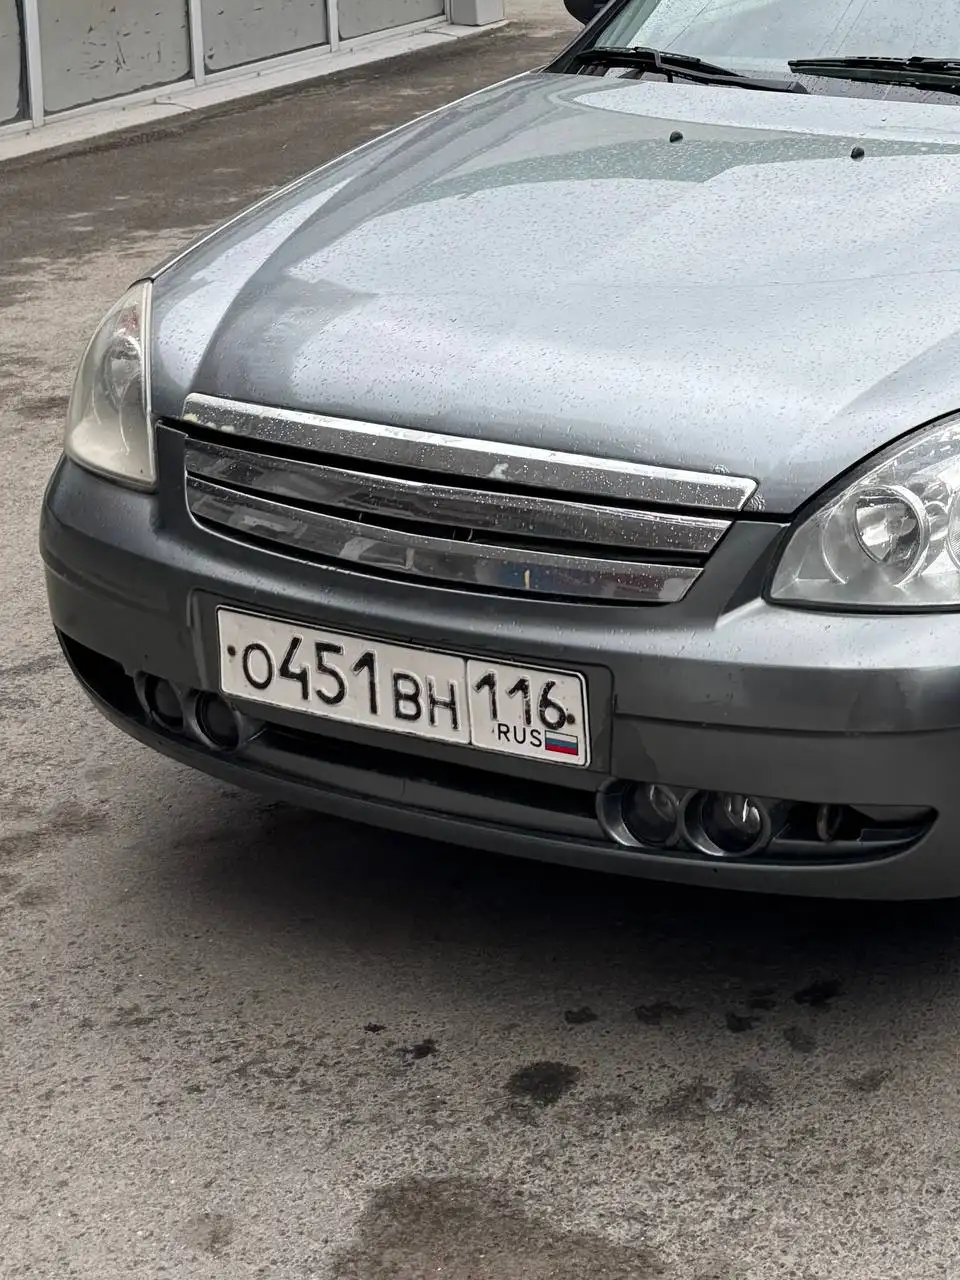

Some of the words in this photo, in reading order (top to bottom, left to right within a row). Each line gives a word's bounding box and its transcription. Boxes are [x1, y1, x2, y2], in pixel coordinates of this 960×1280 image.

[242, 636, 460, 730] О451ВН
[475, 672, 566, 730] 116
[497, 722, 542, 748] RUS
